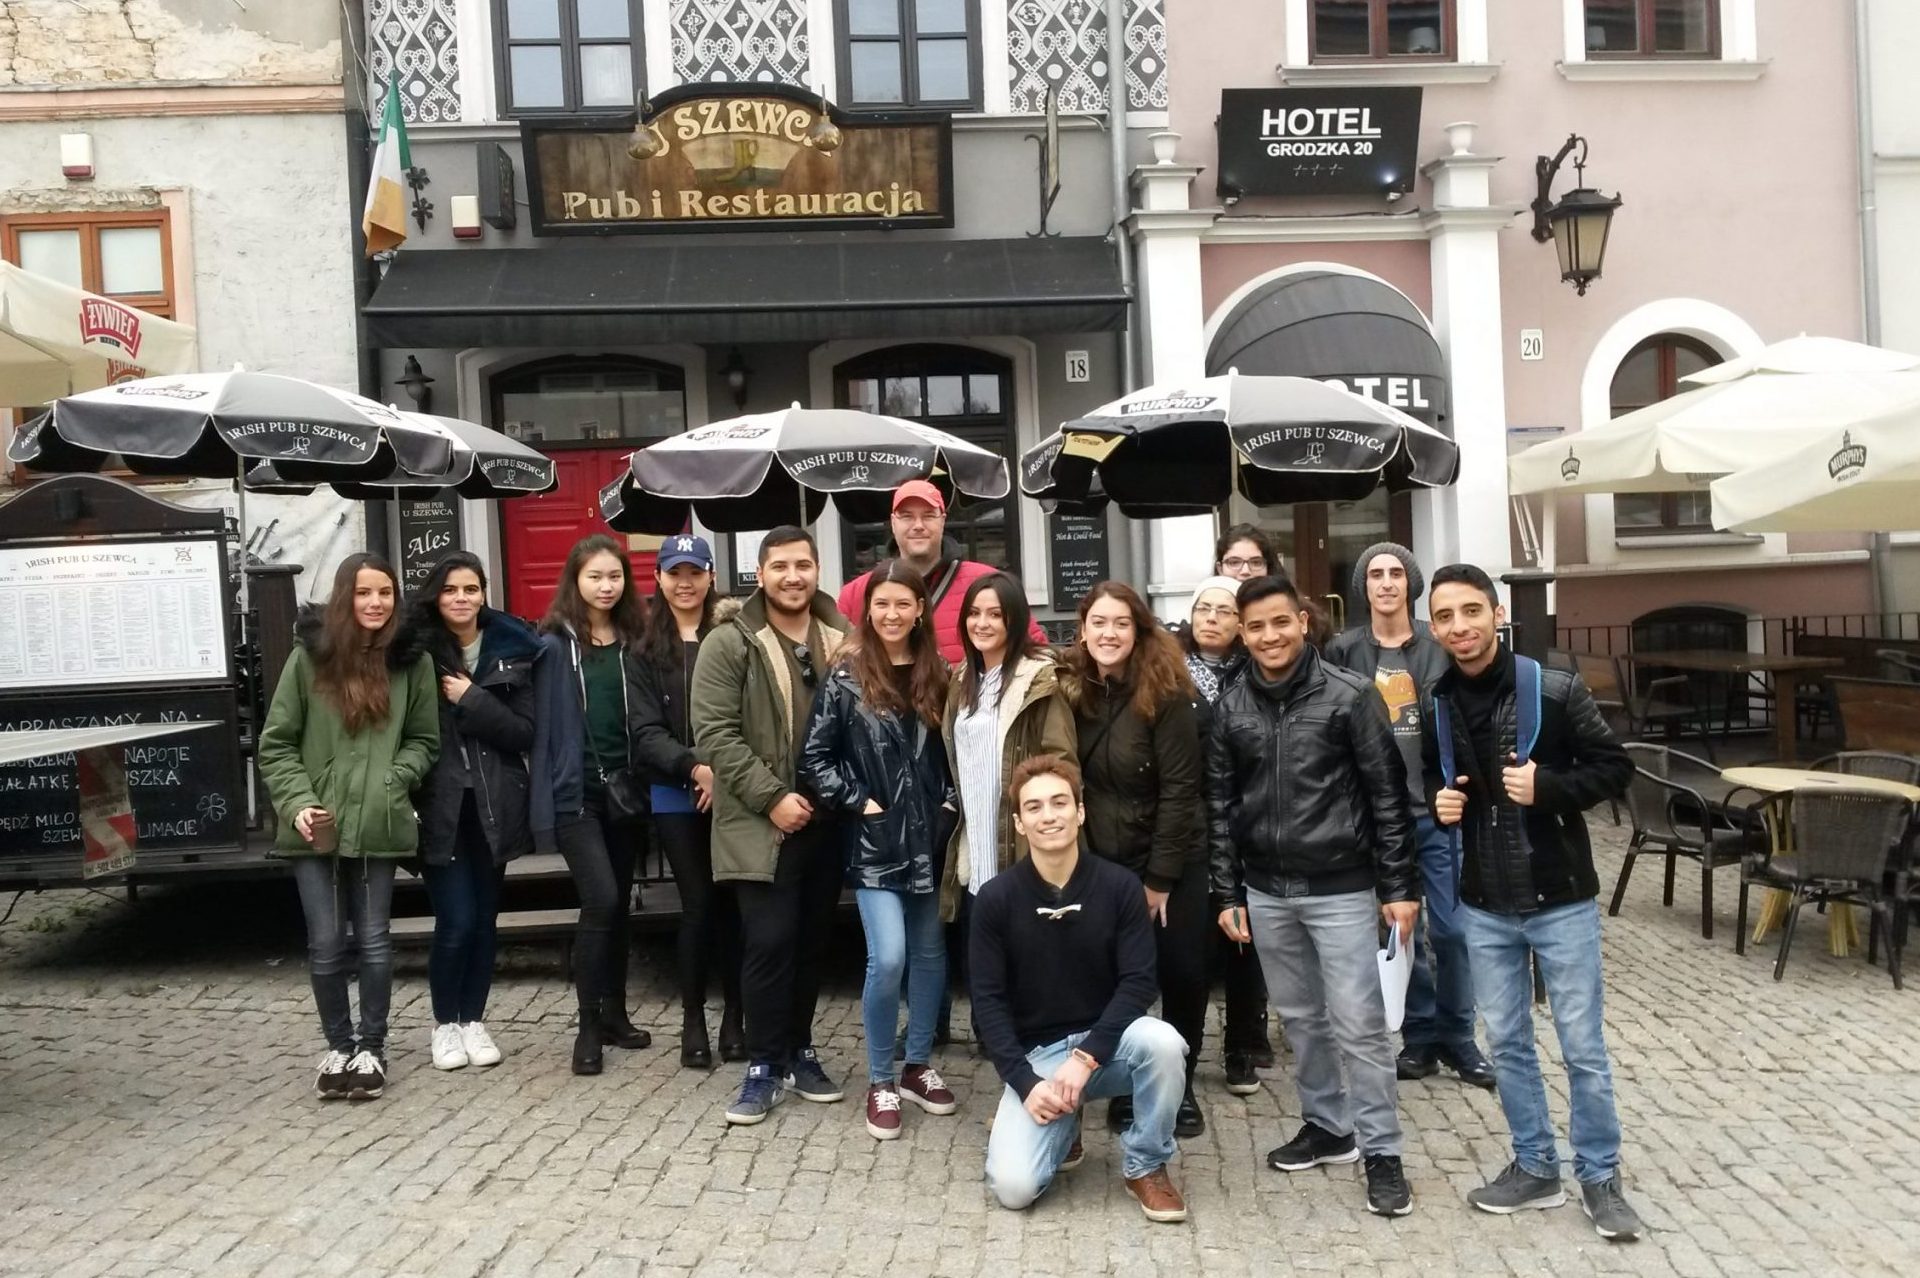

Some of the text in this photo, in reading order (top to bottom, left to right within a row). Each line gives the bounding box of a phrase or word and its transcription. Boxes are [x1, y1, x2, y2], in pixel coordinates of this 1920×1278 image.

[674, 99, 832, 158] SZEWC
[1261, 107, 1382, 137] HOTEL
[1266, 141, 1374, 157] GRODZKA 20
[562, 182, 925, 220] Pub i Restauracja
[87, 300, 136, 341] ŻYWIEC
[1523, 337, 1542, 357] 20
[1070, 359, 1087, 379] 18
[1324, 378, 1430, 408] TEL
[225, 421, 367, 451] IRISH PUB U SZEWCA
[1242, 427, 1386, 454] IRISH PUB U SZEWCA
[789, 451, 925, 476] IRISH PUB U SZEWCA
[402, 508, 454, 518] U SZEWCA
[406, 529, 451, 559] Ales
[125, 747, 190, 769] NAPOJE
[35, 812, 75, 828] MIŁO
[136, 820, 198, 838] LIMACIE
